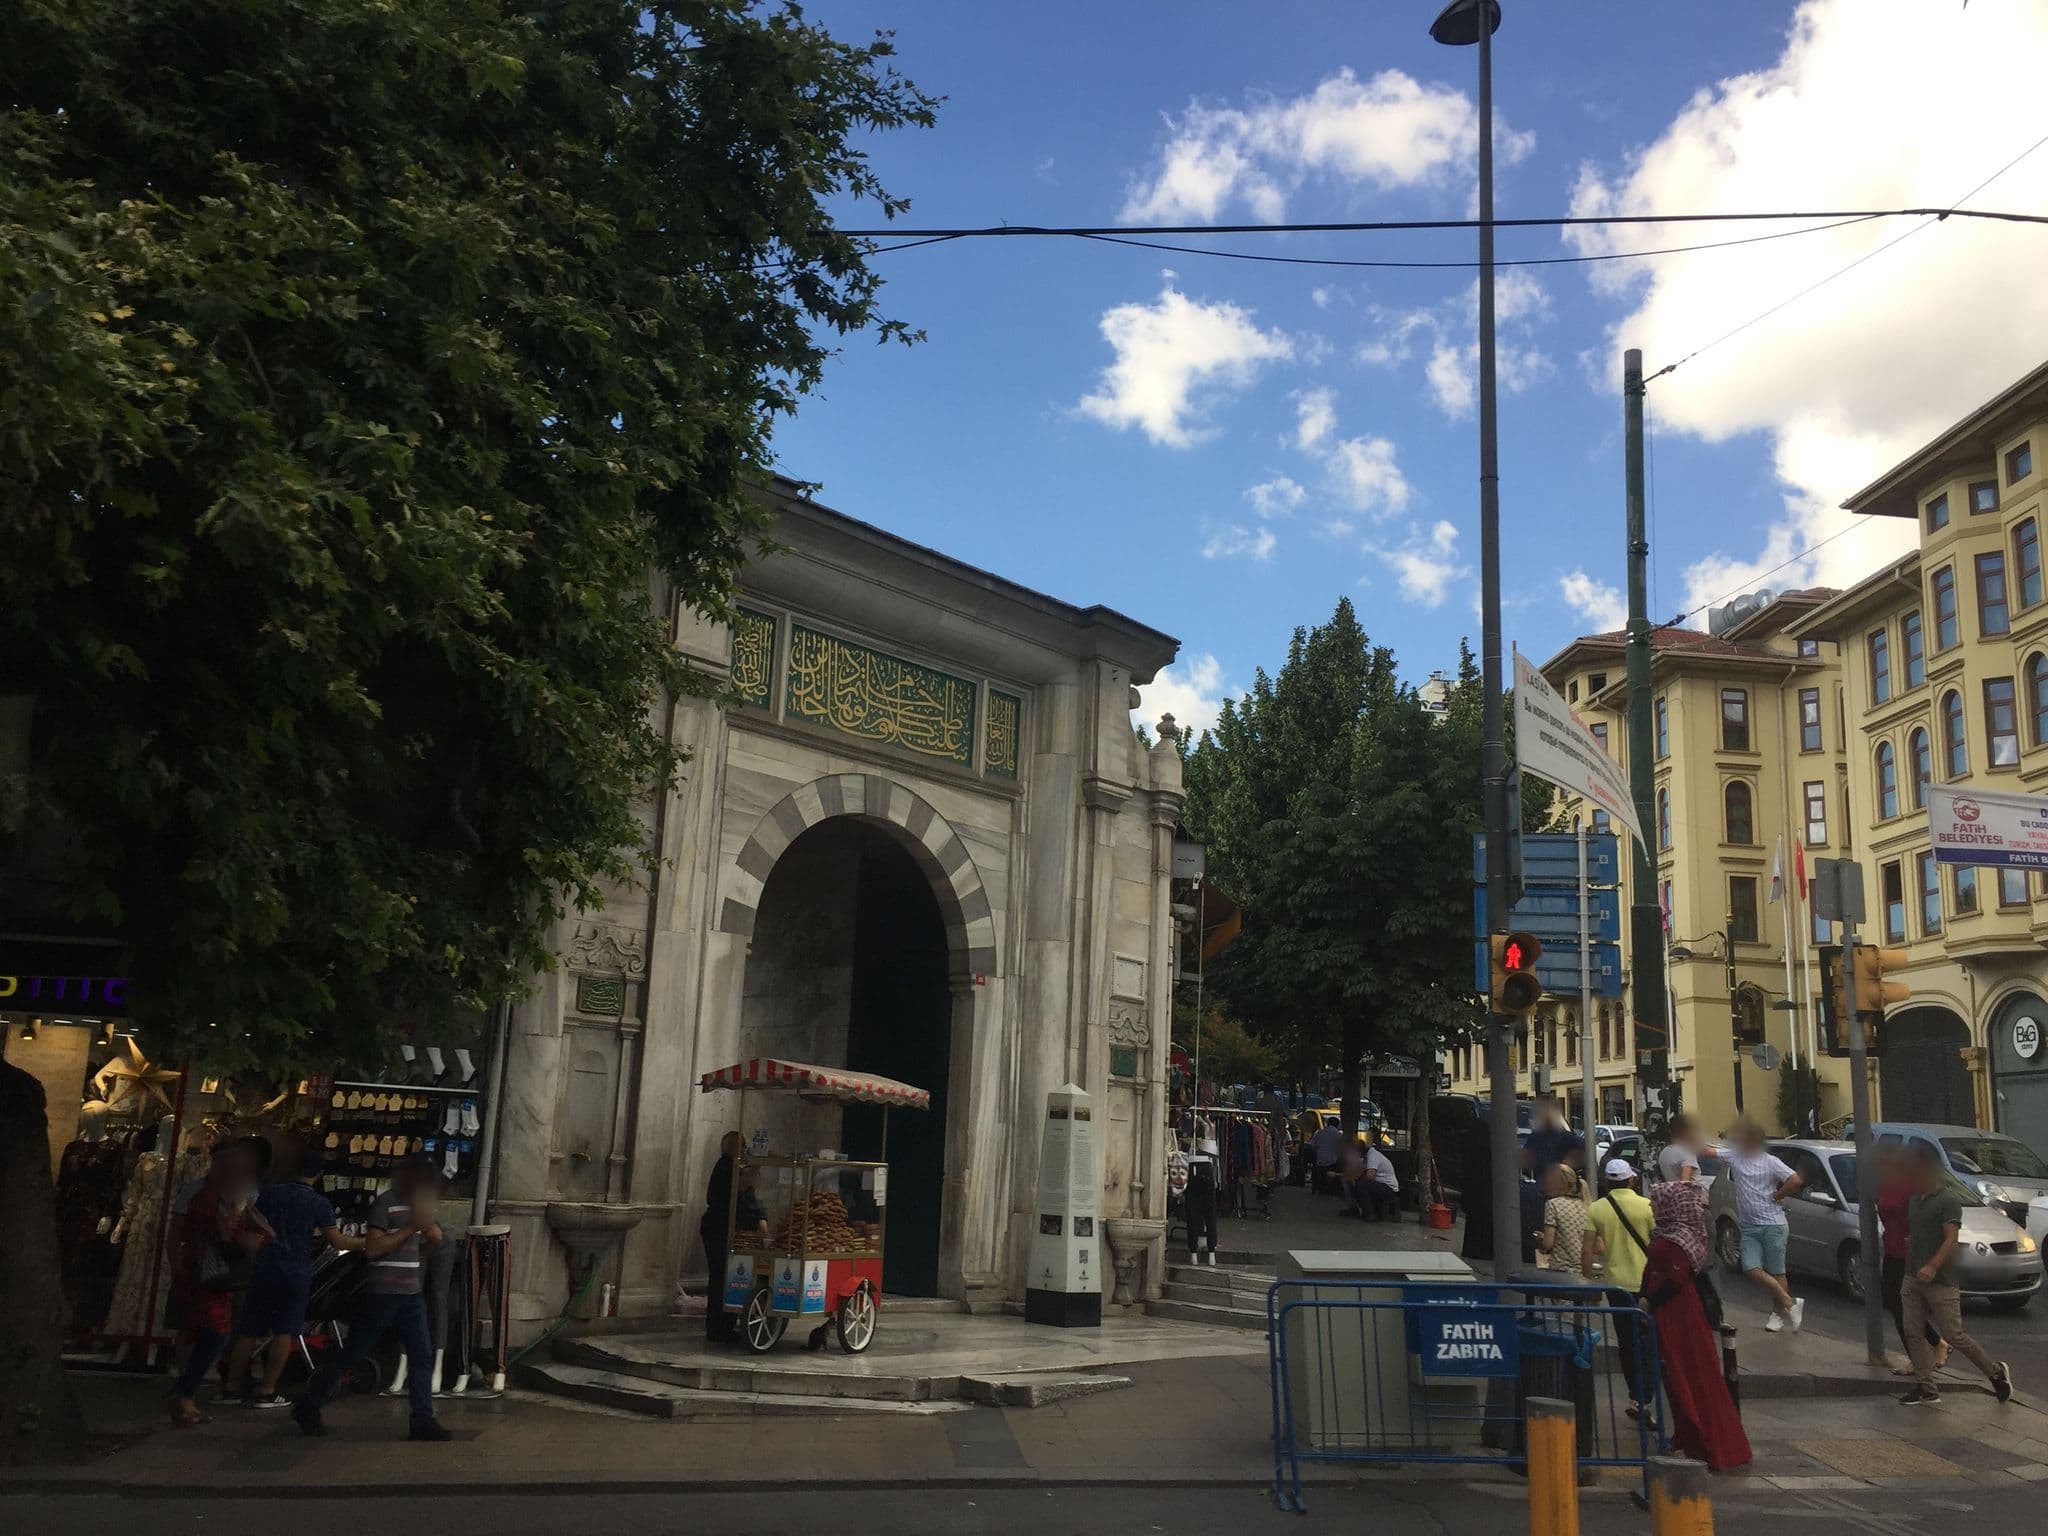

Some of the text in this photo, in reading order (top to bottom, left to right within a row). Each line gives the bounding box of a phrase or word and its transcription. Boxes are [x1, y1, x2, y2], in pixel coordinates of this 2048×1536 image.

[1952, 823, 1987, 833] FATİH
[1938, 832, 2004, 845] BELEDİYESİ
[2009, 853, 2039, 864] FATİH
[1442, 1321, 1494, 1339] FATİH
[1437, 1343, 1503, 1359] ZABITA
